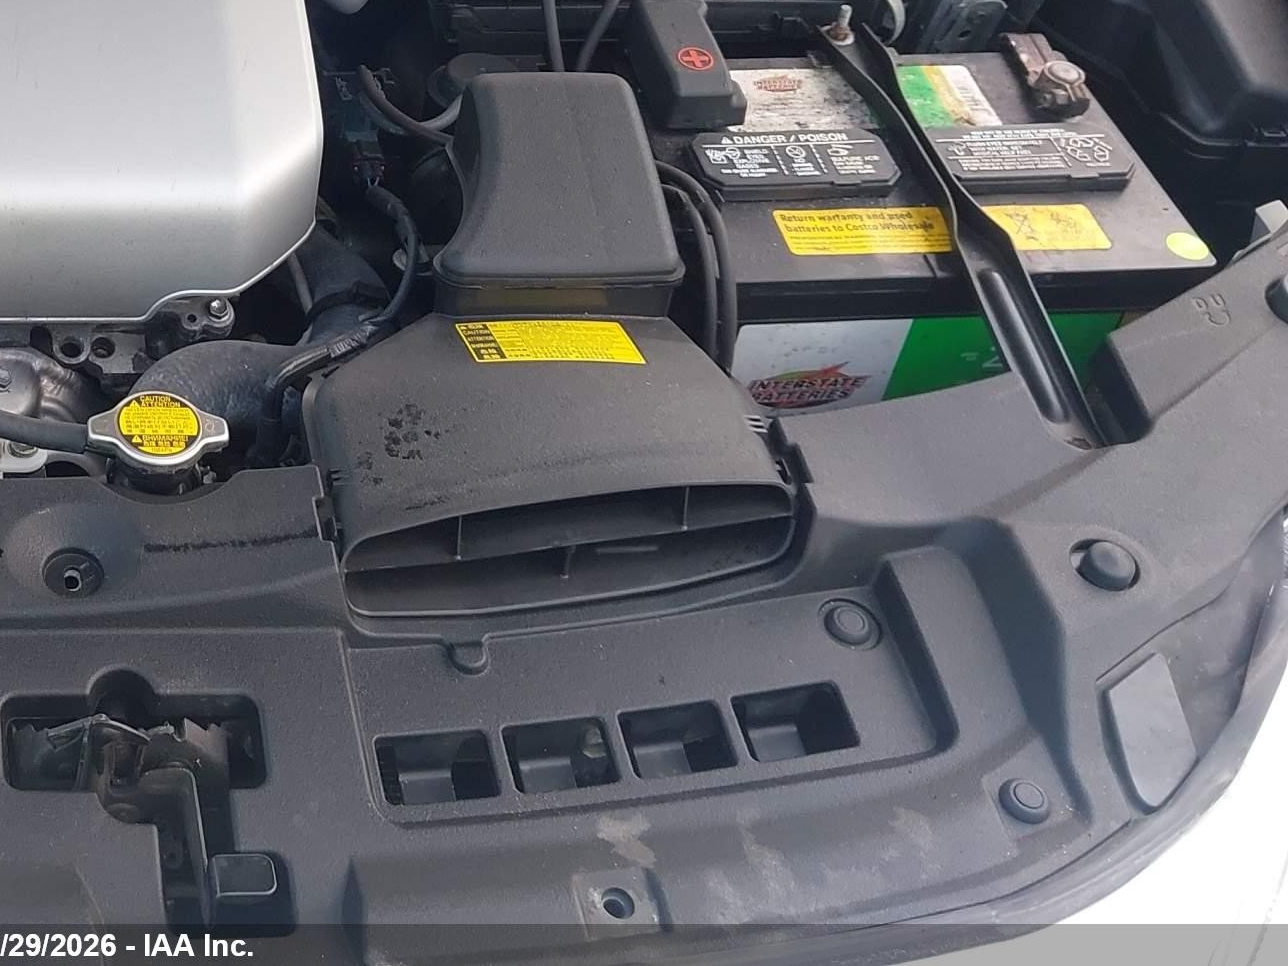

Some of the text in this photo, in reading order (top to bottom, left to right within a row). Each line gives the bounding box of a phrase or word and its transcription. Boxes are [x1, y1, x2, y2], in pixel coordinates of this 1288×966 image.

[733, 134, 788, 145] DANGER
[798, 132, 849, 142] POISON
[780, 211, 913, 223] Return warranty and used
[785, 221, 936, 232] batteries to Costco Wholesale
[750, 375, 863, 389] INTERSTATE
[140, 395, 171, 403] CAUTION
[751, 387, 853, 403] BATTERIES
